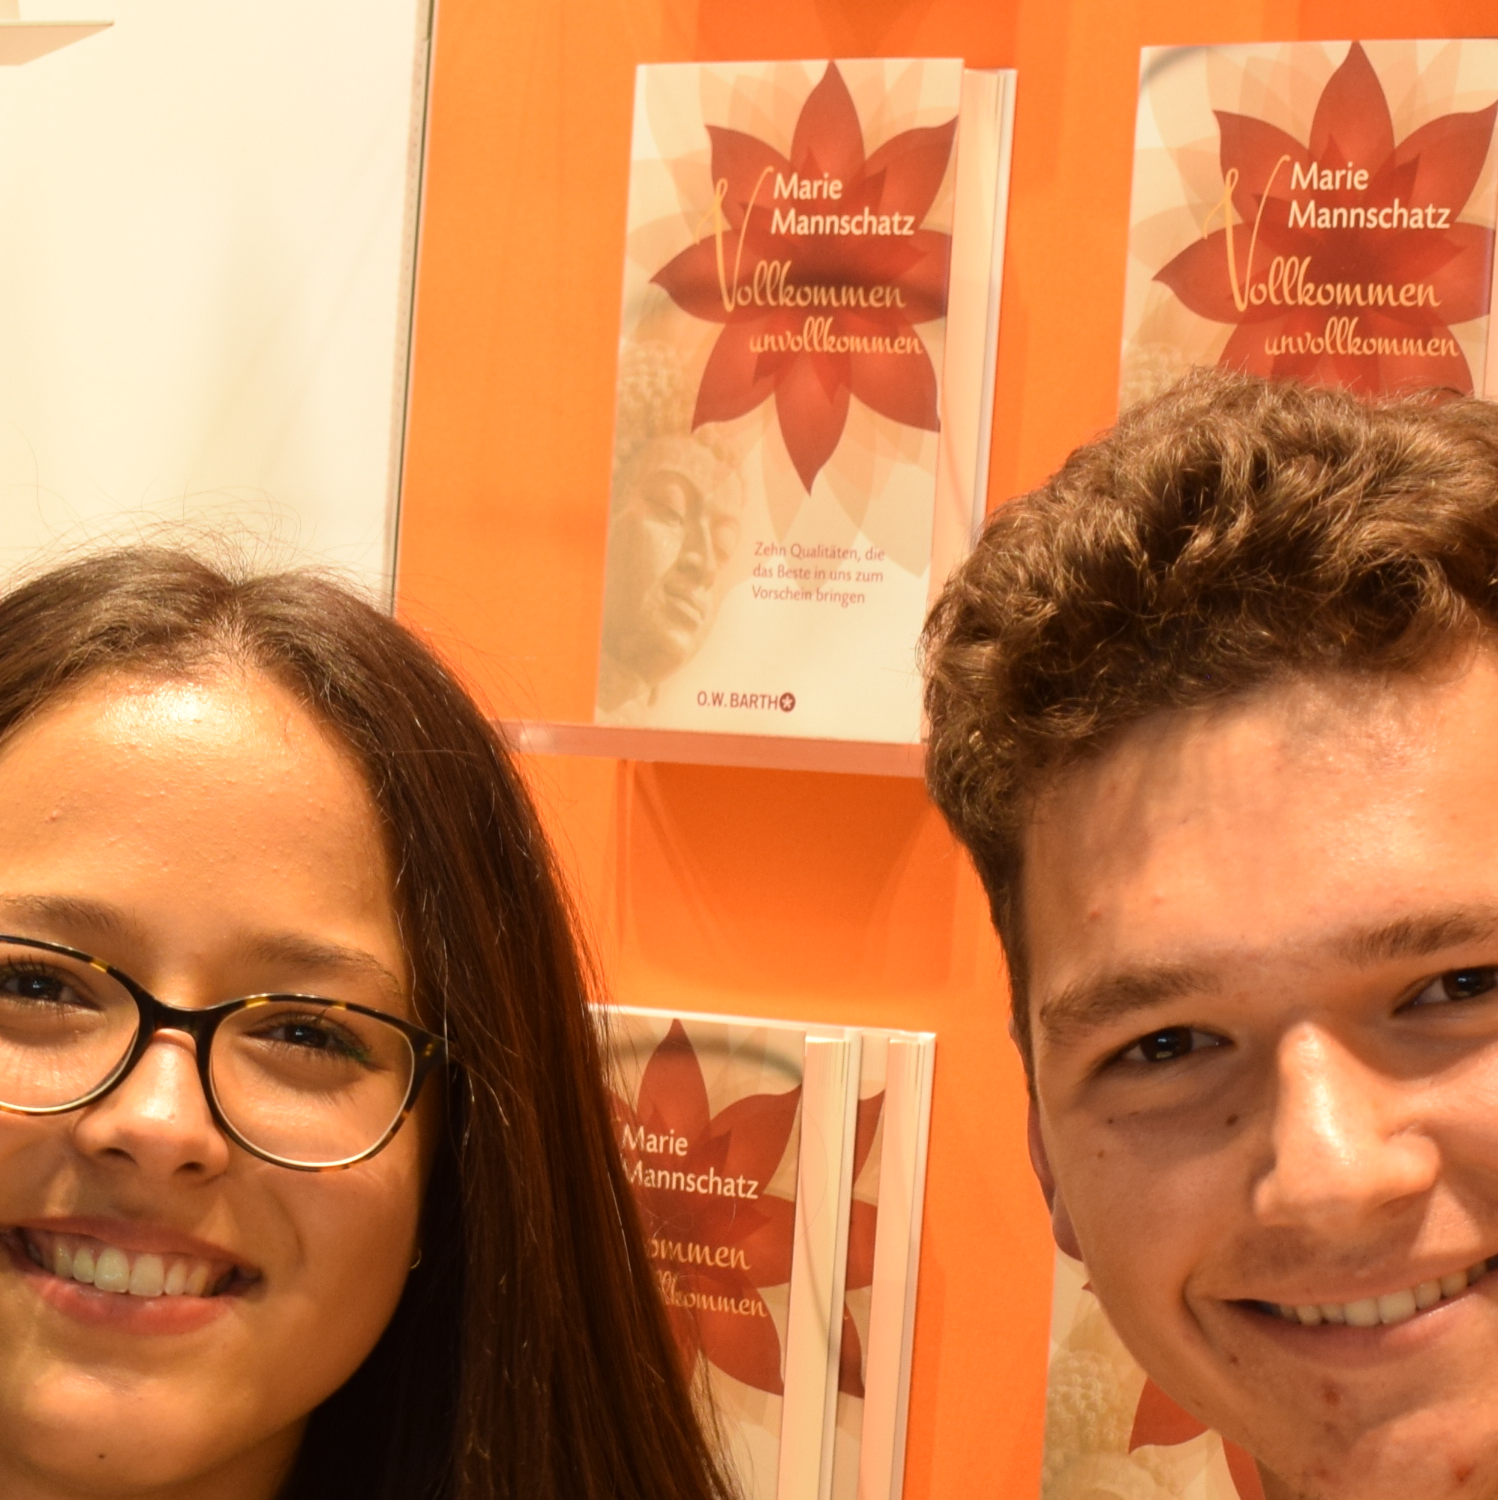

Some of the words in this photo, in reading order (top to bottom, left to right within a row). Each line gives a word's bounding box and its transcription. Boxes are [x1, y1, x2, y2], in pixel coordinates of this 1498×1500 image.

[774, 172, 843, 200] Marie
[1290, 162, 1369, 190] Marie
[771, 207, 915, 236] Mannschatz
[1288, 199, 1451, 229] Mannschatz
[696, 166, 906, 312] Vollkommen
[1203, 154, 1442, 312] Vollkommen
[749, 317, 923, 355] unvollkommen
[1264, 316, 1459, 357] unvollkommen
[754, 541, 787, 557] Zehn
[790, 542, 862, 563] Qualitäten,
[864, 546, 885, 562] die
[753, 563, 775, 580] das
[778, 564, 811, 581] Beste
[814, 566, 826, 581] in
[830, 569, 852, 582] uns
[855, 569, 884, 584] zum
[752, 584, 813, 604] Vorschein
[816, 587, 865, 608] bringen
[697, 691, 728, 708] O.W.
[730, 693, 779, 711] BARTH
[621, 1124, 688, 1157] Marie
